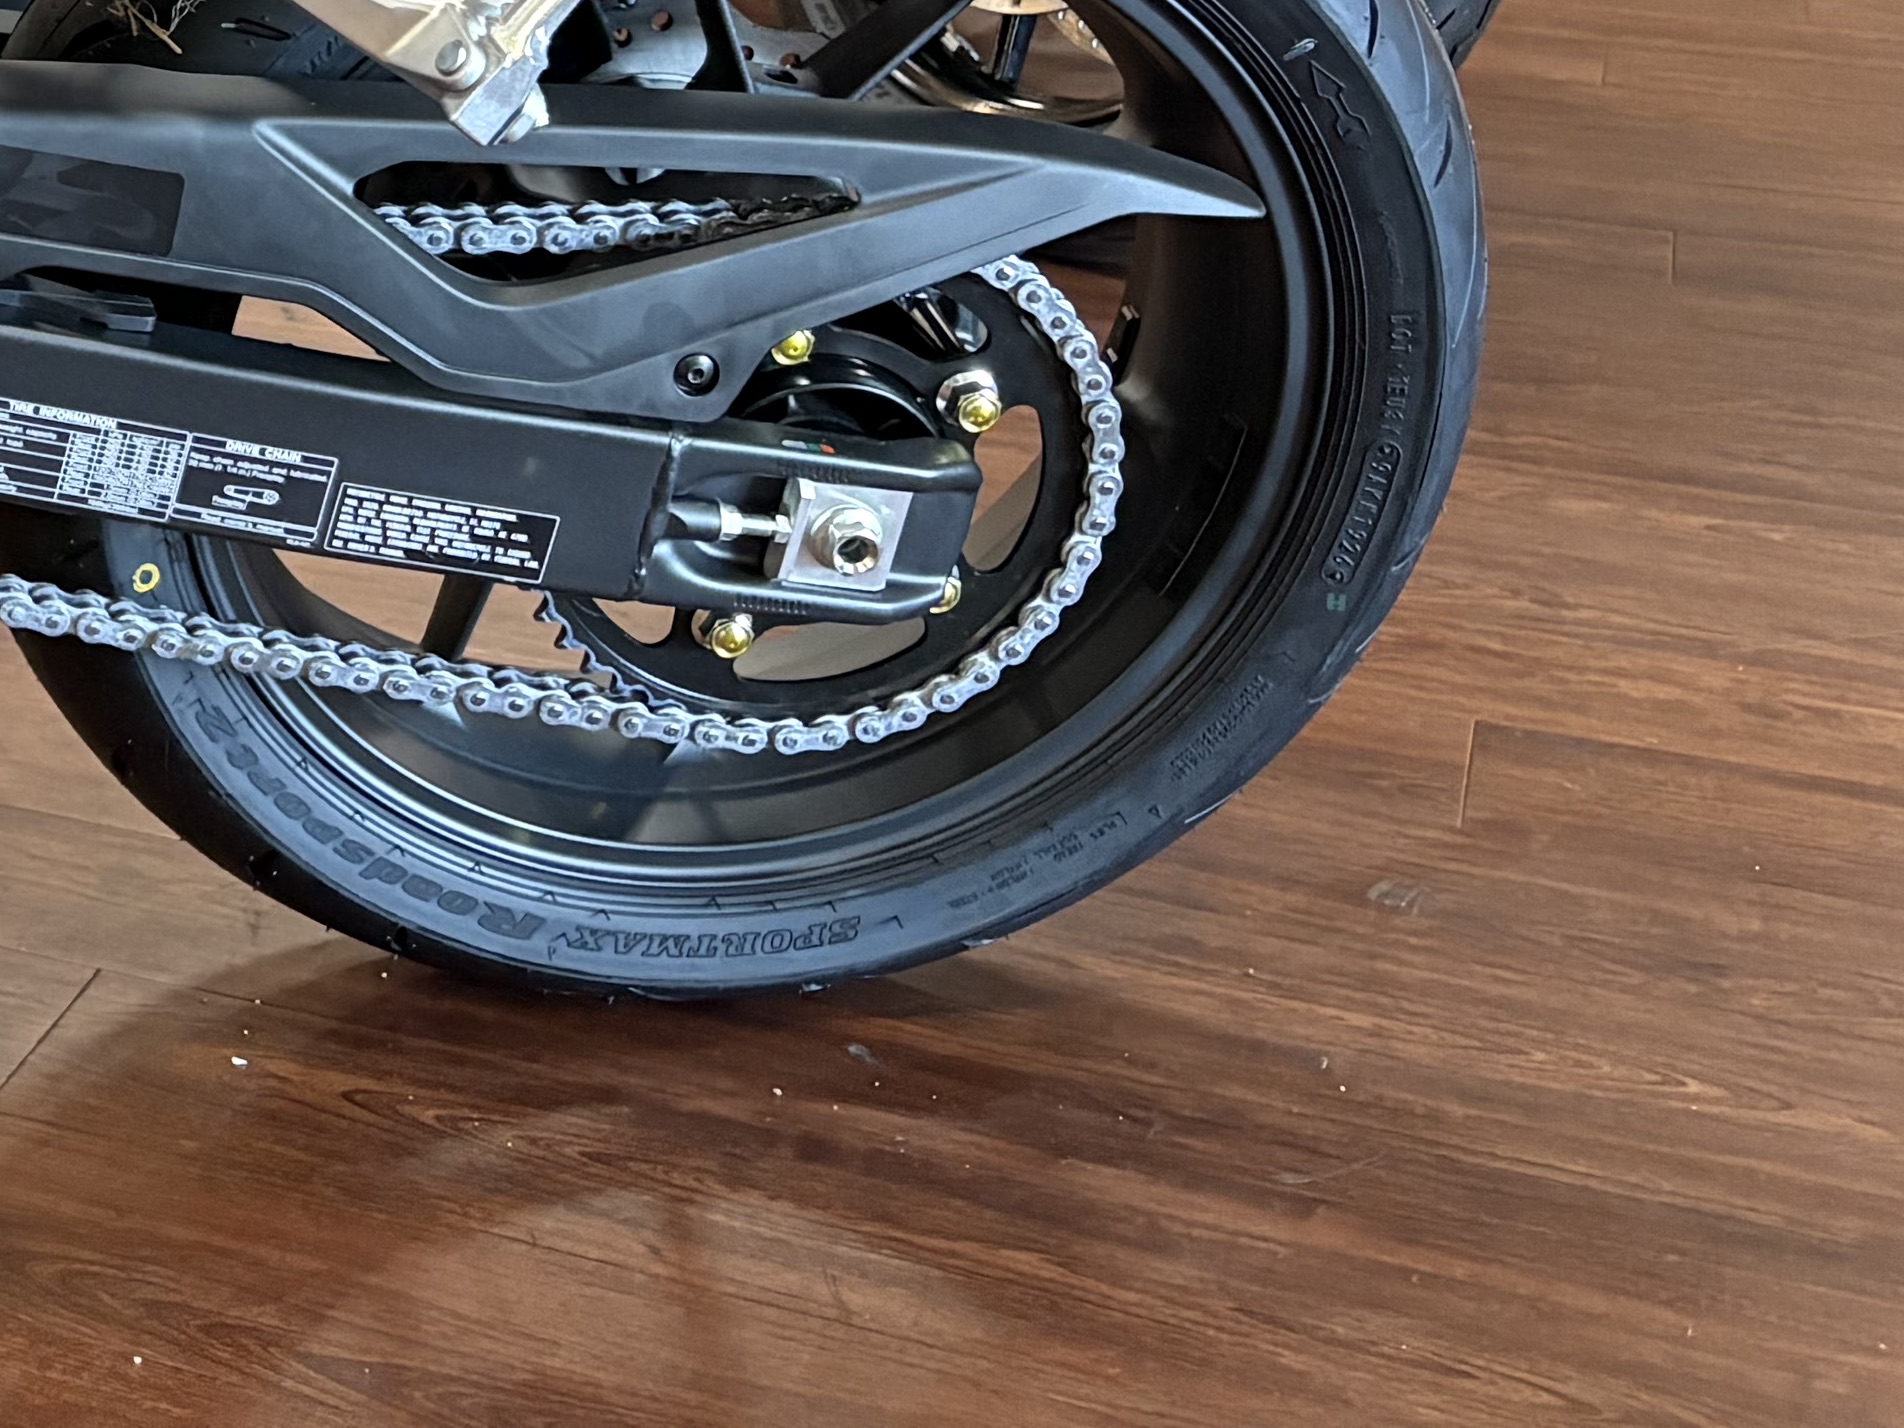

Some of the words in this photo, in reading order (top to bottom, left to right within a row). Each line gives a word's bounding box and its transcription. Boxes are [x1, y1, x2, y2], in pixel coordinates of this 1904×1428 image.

[9, 401, 34, 416] TIRE
[38, 405, 117, 429] INFORMATION
[225, 439, 261, 456] DRIVE
[264, 447, 303, 464] CHAIN
[195, 703, 242, 741] 2
[225, 743, 546, 943] Roadsport
[565, 916, 861, 959] SPORTMAX
